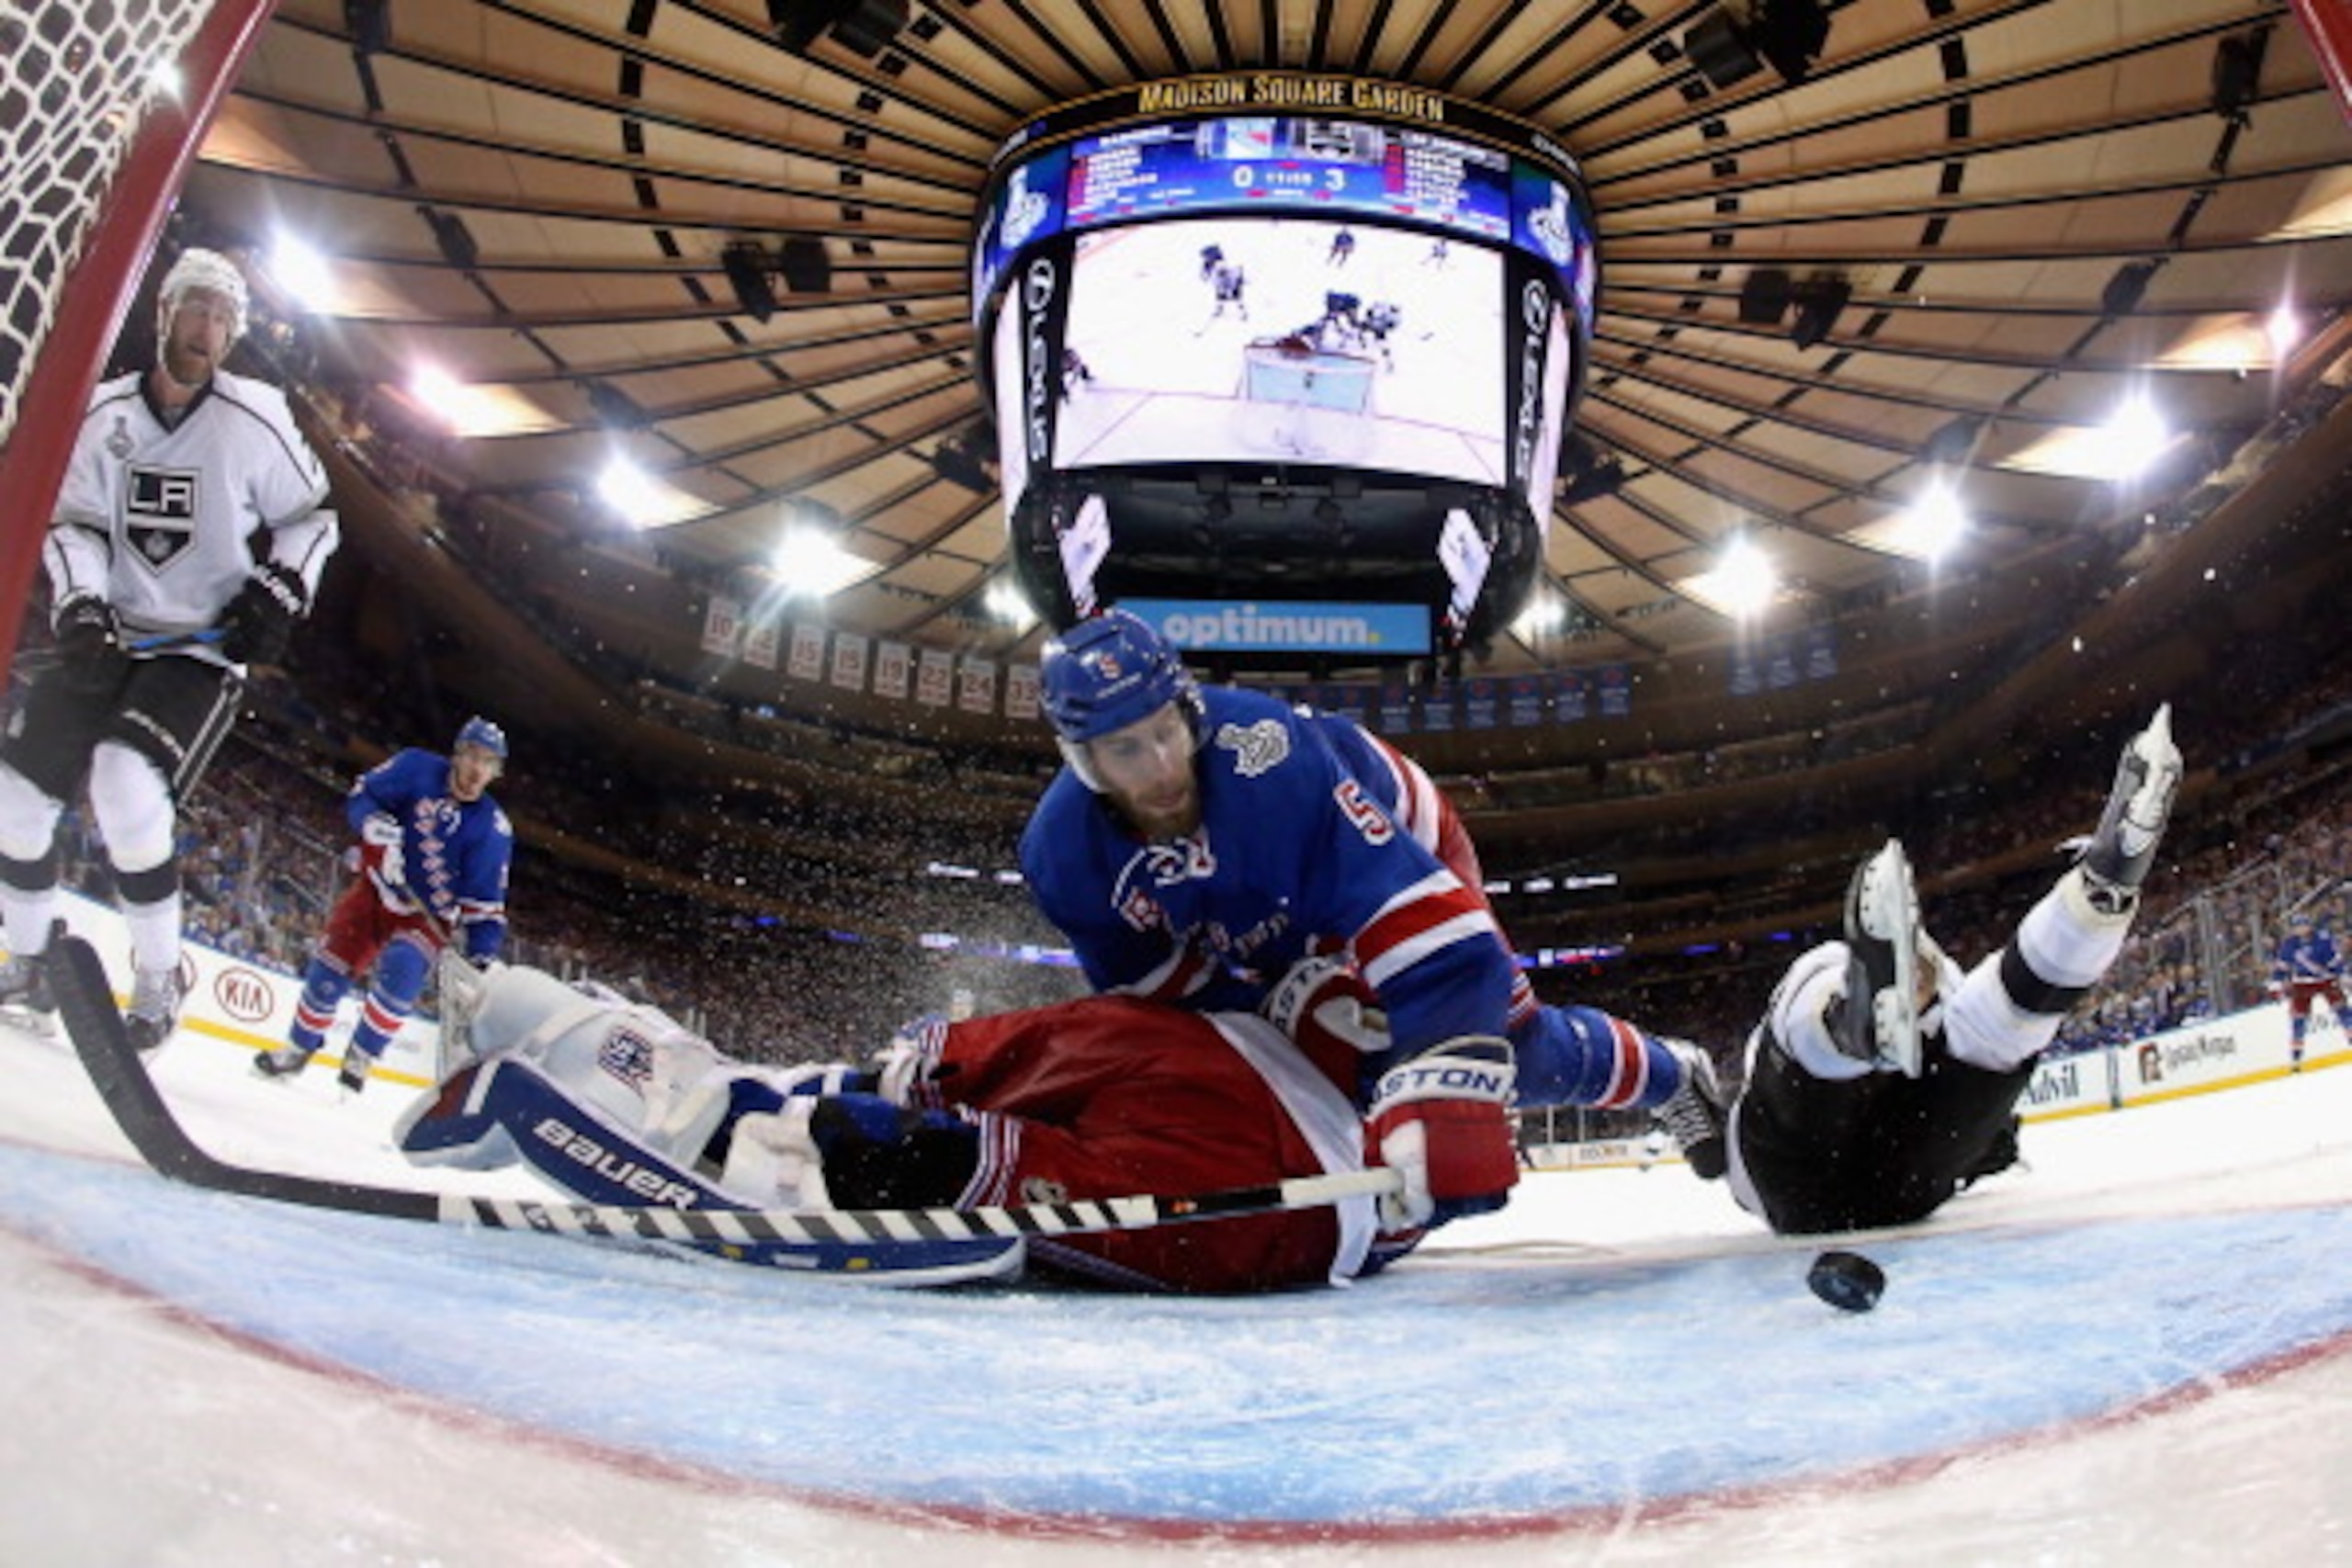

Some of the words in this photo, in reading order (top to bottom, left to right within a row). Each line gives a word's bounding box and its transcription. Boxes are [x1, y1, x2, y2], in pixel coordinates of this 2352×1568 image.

[1137, 77, 1246, 113] MADISON
[1252, 73, 1347, 107] SQUARE
[1351, 79, 1444, 121] GARDEN
[1233, 164, 1254, 188] 0
[1324, 167, 1346, 191] 3
[130, 472, 192, 513] LA
[1332, 780, 1396, 847] 5
[224, 978, 266, 1014] KIA
[1378, 1067, 1500, 1099] STON
[532, 1117, 698, 1211] BAUER
